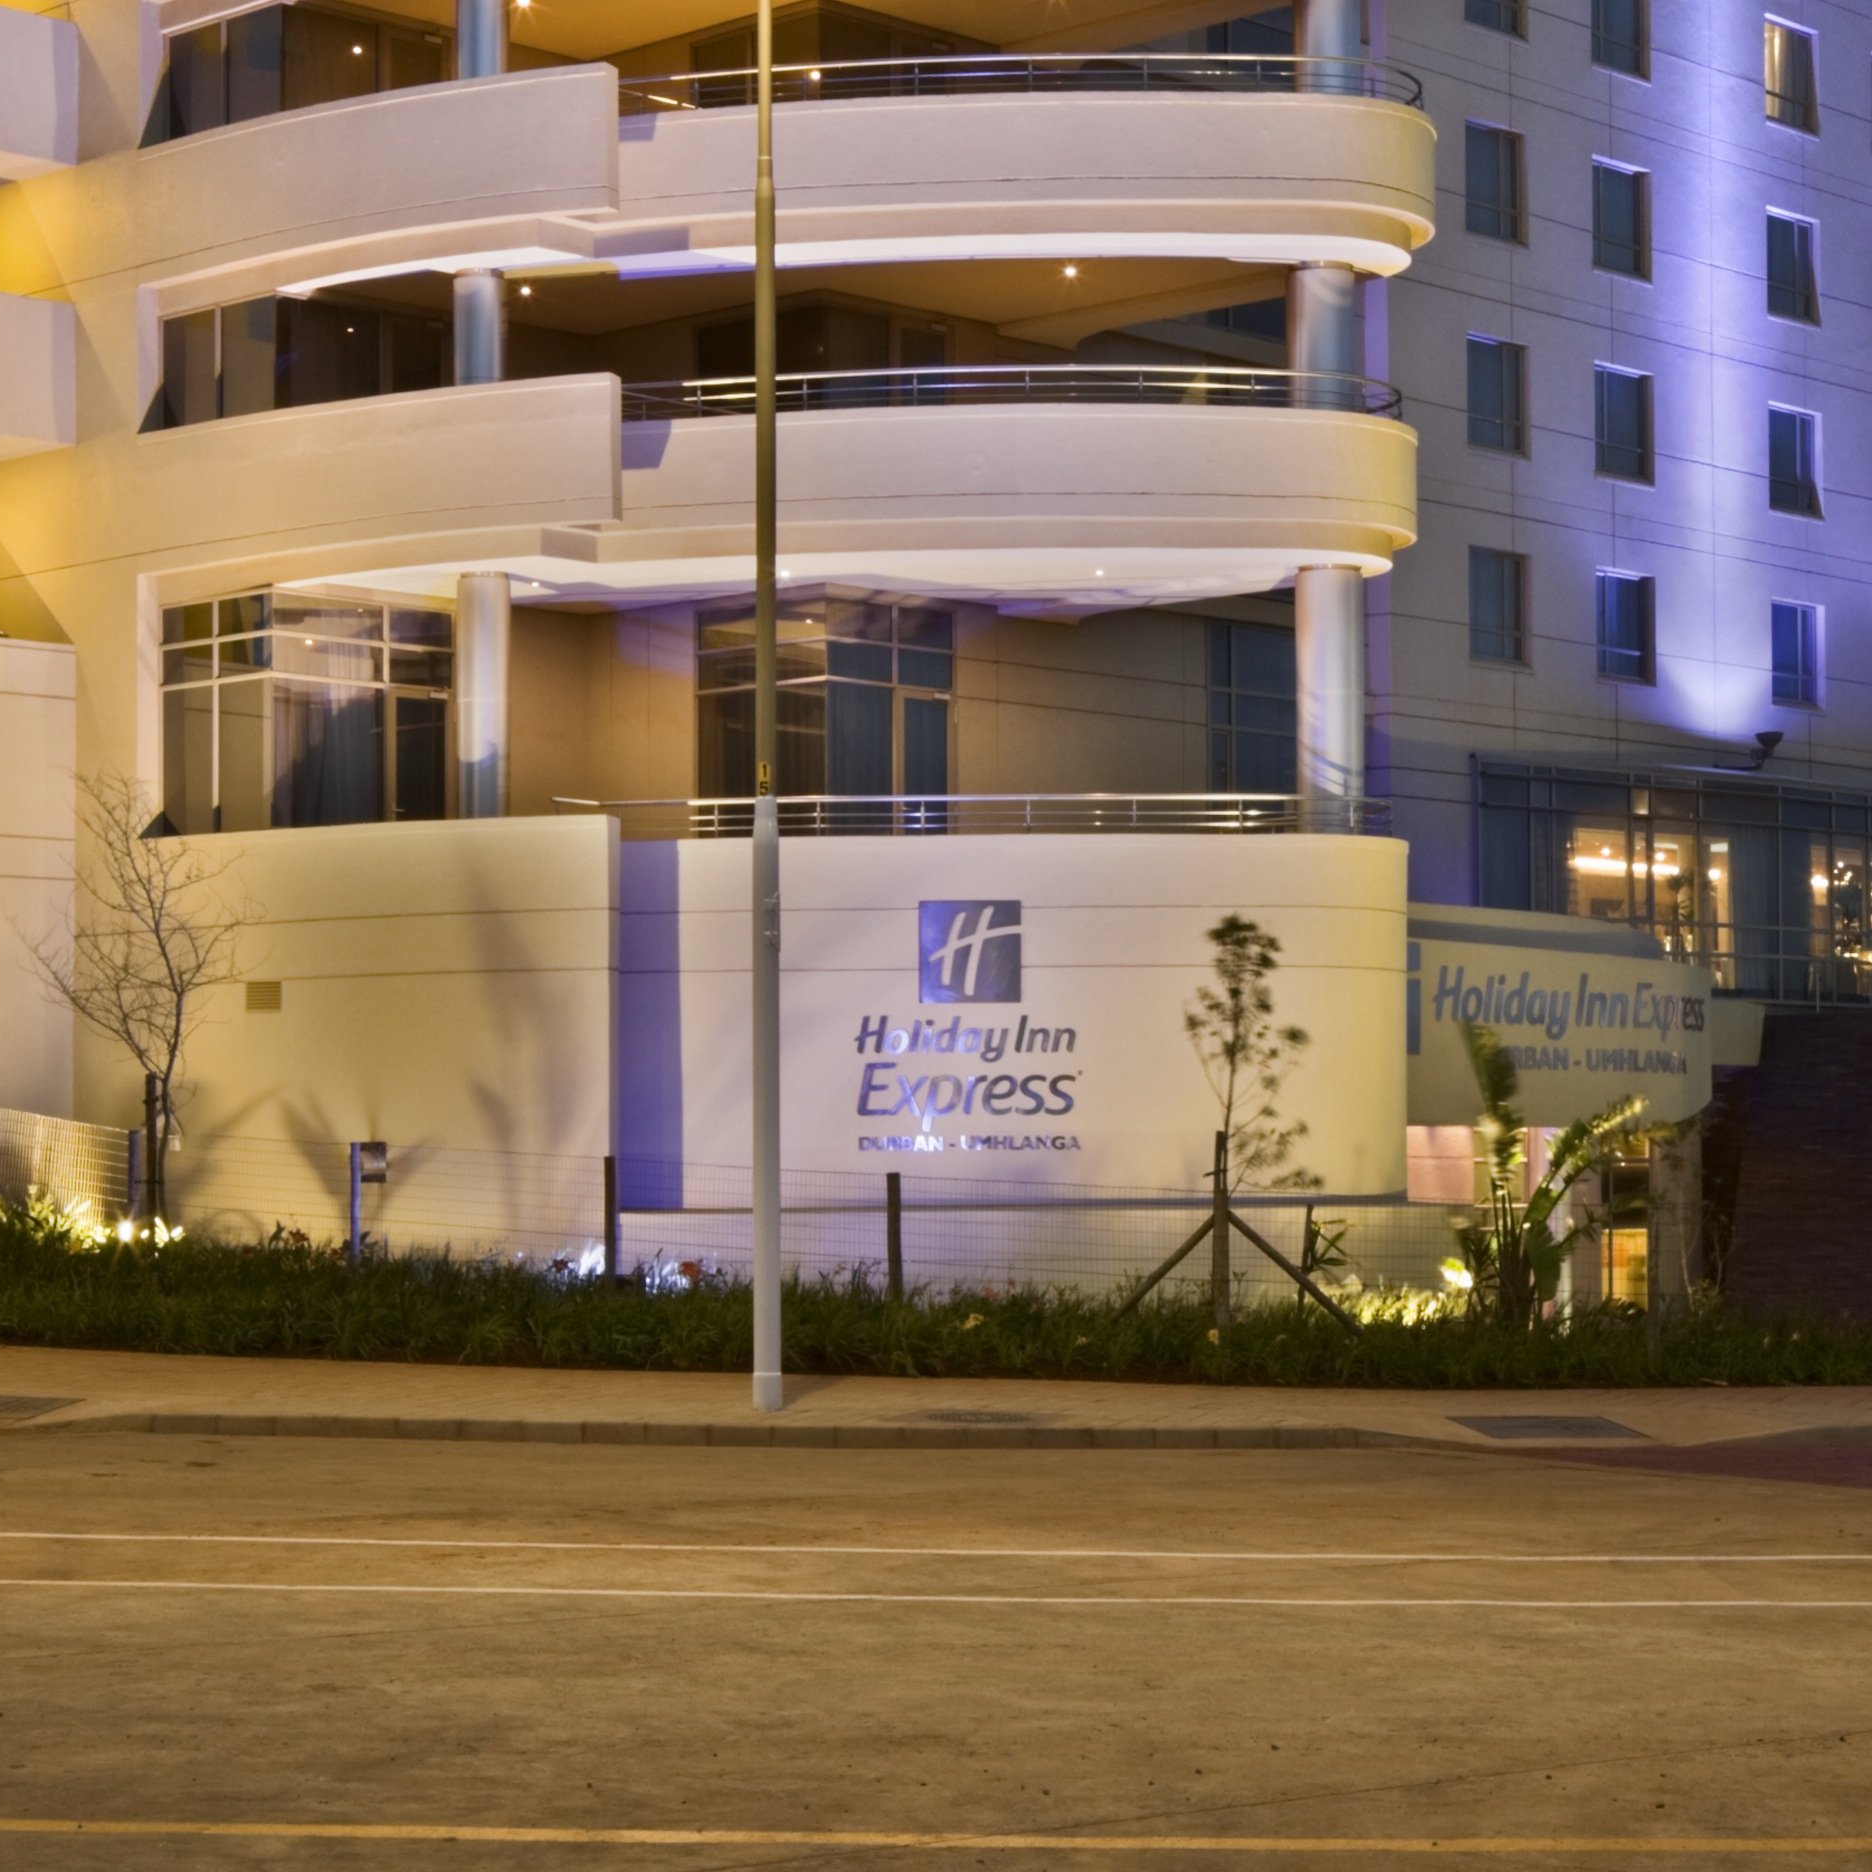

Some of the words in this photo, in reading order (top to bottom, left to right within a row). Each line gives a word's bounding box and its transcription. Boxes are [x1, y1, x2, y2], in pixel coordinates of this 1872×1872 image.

[1433, 965, 1571, 1040] Holiday
[1575, 973, 1628, 1028] Inn
[1633, 982, 1705, 1042] Express
[854, 1015, 1009, 1063] Holiday
[1014, 1014, 1077, 1054] Inn
[1586, 1048, 1688, 1075] UMHLANGA
[857, 1062, 1076, 1132] Express
[858, 1135, 944, 1152] DURBAN
[960, 1135, 1082, 1152] UMHLANGA
